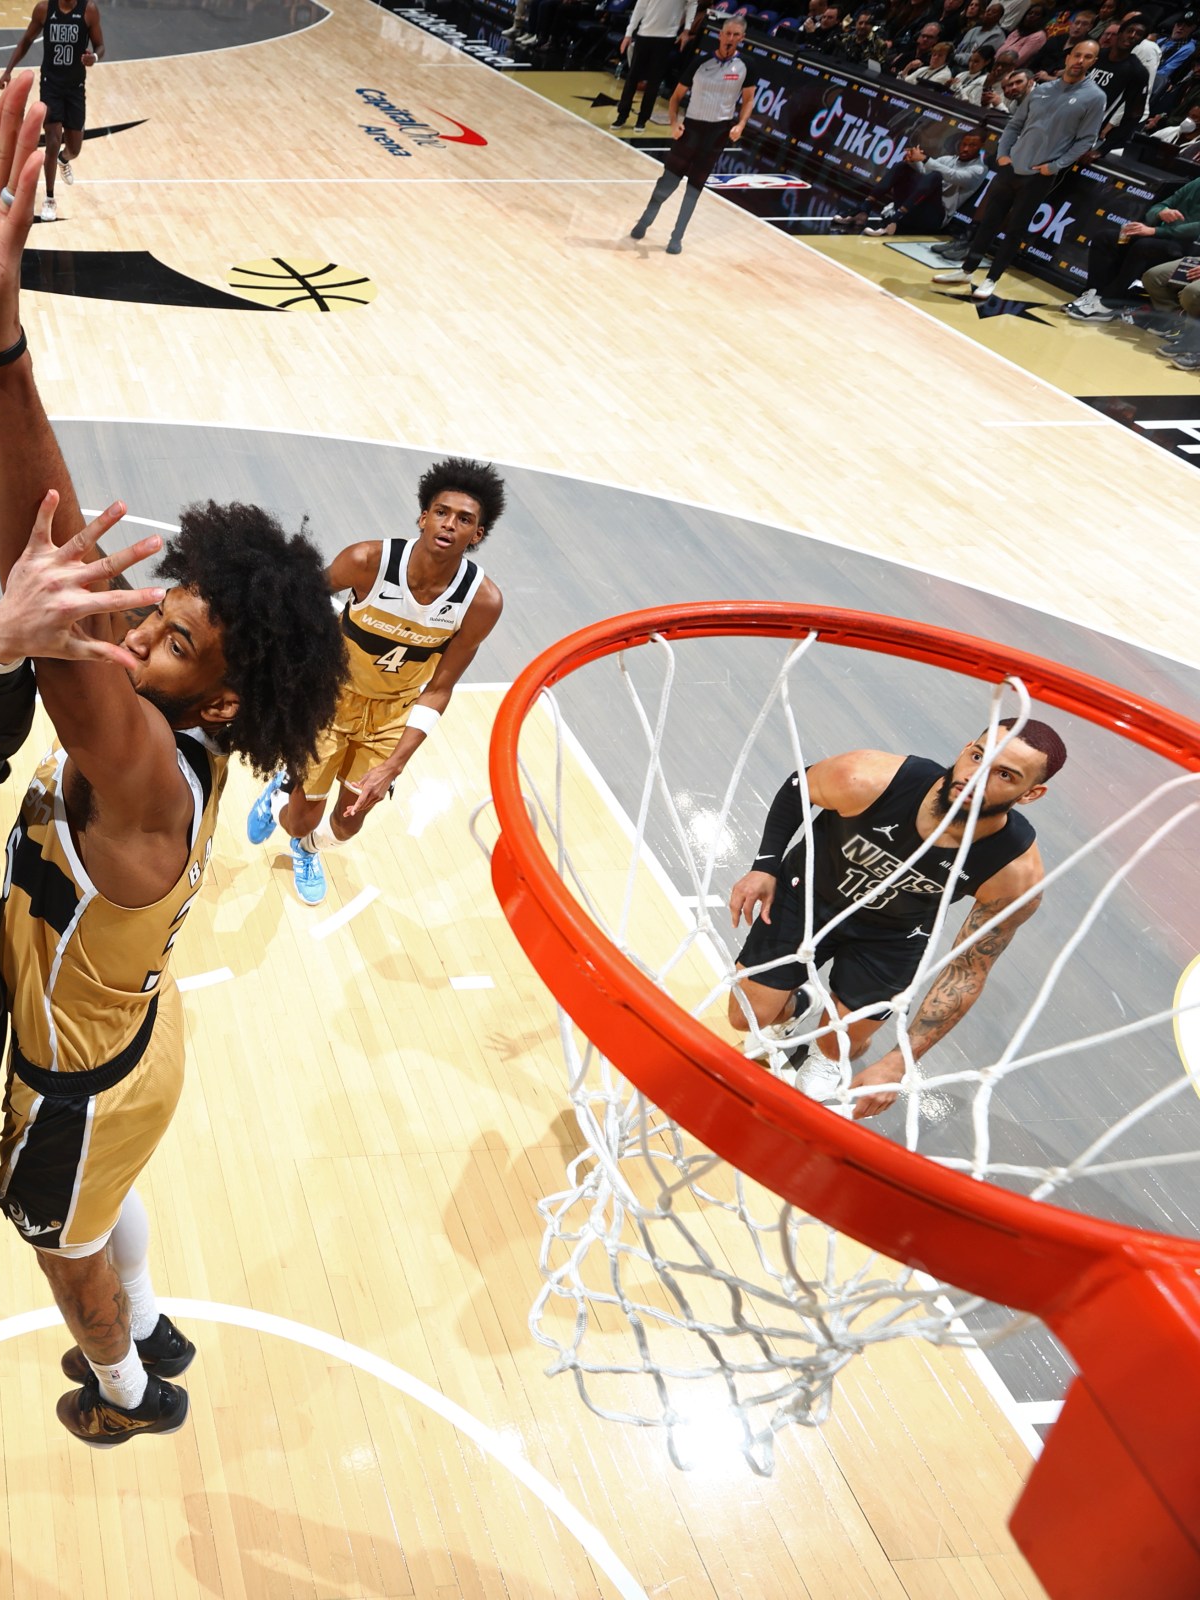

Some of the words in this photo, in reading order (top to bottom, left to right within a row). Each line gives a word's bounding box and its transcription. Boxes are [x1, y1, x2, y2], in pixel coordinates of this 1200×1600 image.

[50, 23, 79, 43] NETS
[53, 44, 74, 66] 20
[1089, 67, 1113, 86] NETS
[355, 88, 430, 127] Capital
[358, 124, 412, 156] Arena
[833, 112, 908, 169] TikTok
[361, 613, 450, 645] washington
[429, 616, 455, 625] Robinhood
[373, 645, 409, 673] 4
[836, 868, 898, 910] 13
